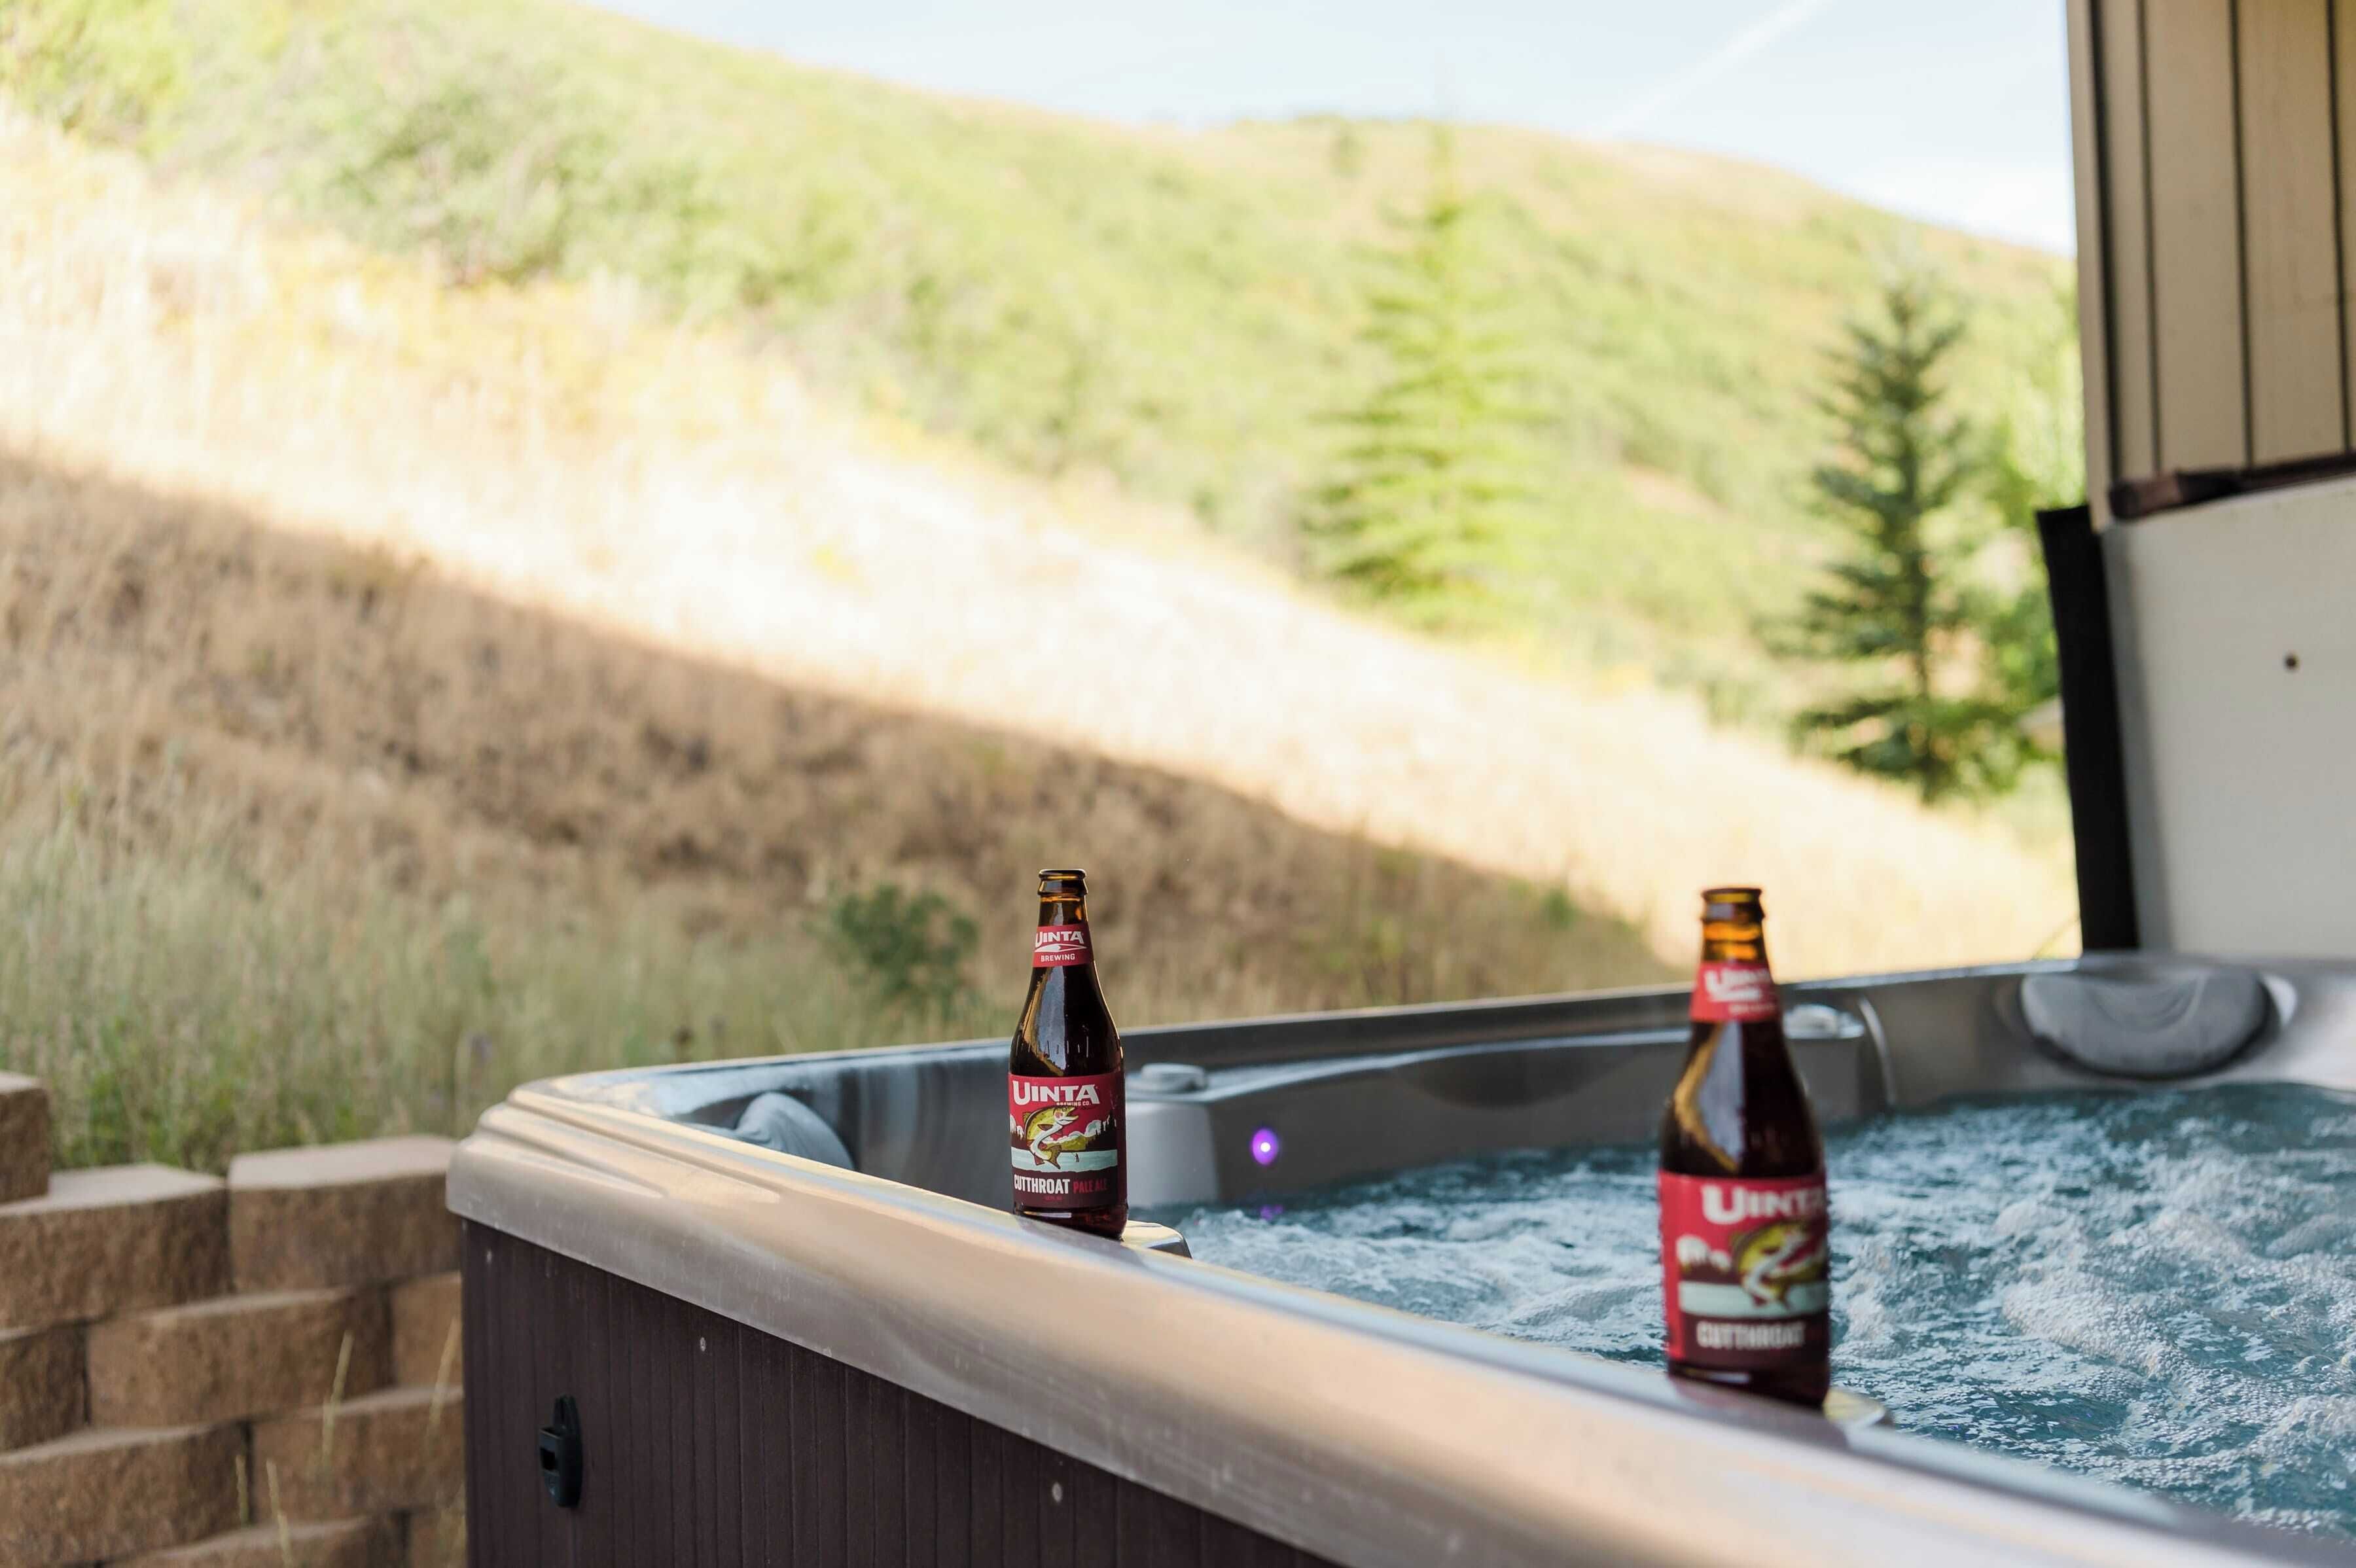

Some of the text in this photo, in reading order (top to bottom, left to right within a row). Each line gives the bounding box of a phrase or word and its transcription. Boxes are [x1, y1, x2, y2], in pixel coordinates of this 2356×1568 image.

[1035, 931, 1084, 948] UINTA
[1041, 953, 1075, 962] BREWING
[1013, 1080, 1099, 1105] UINTA
[1014, 1174, 1070, 1194] CUTTHROAT
[1073, 1181, 1094, 1194] PALE
